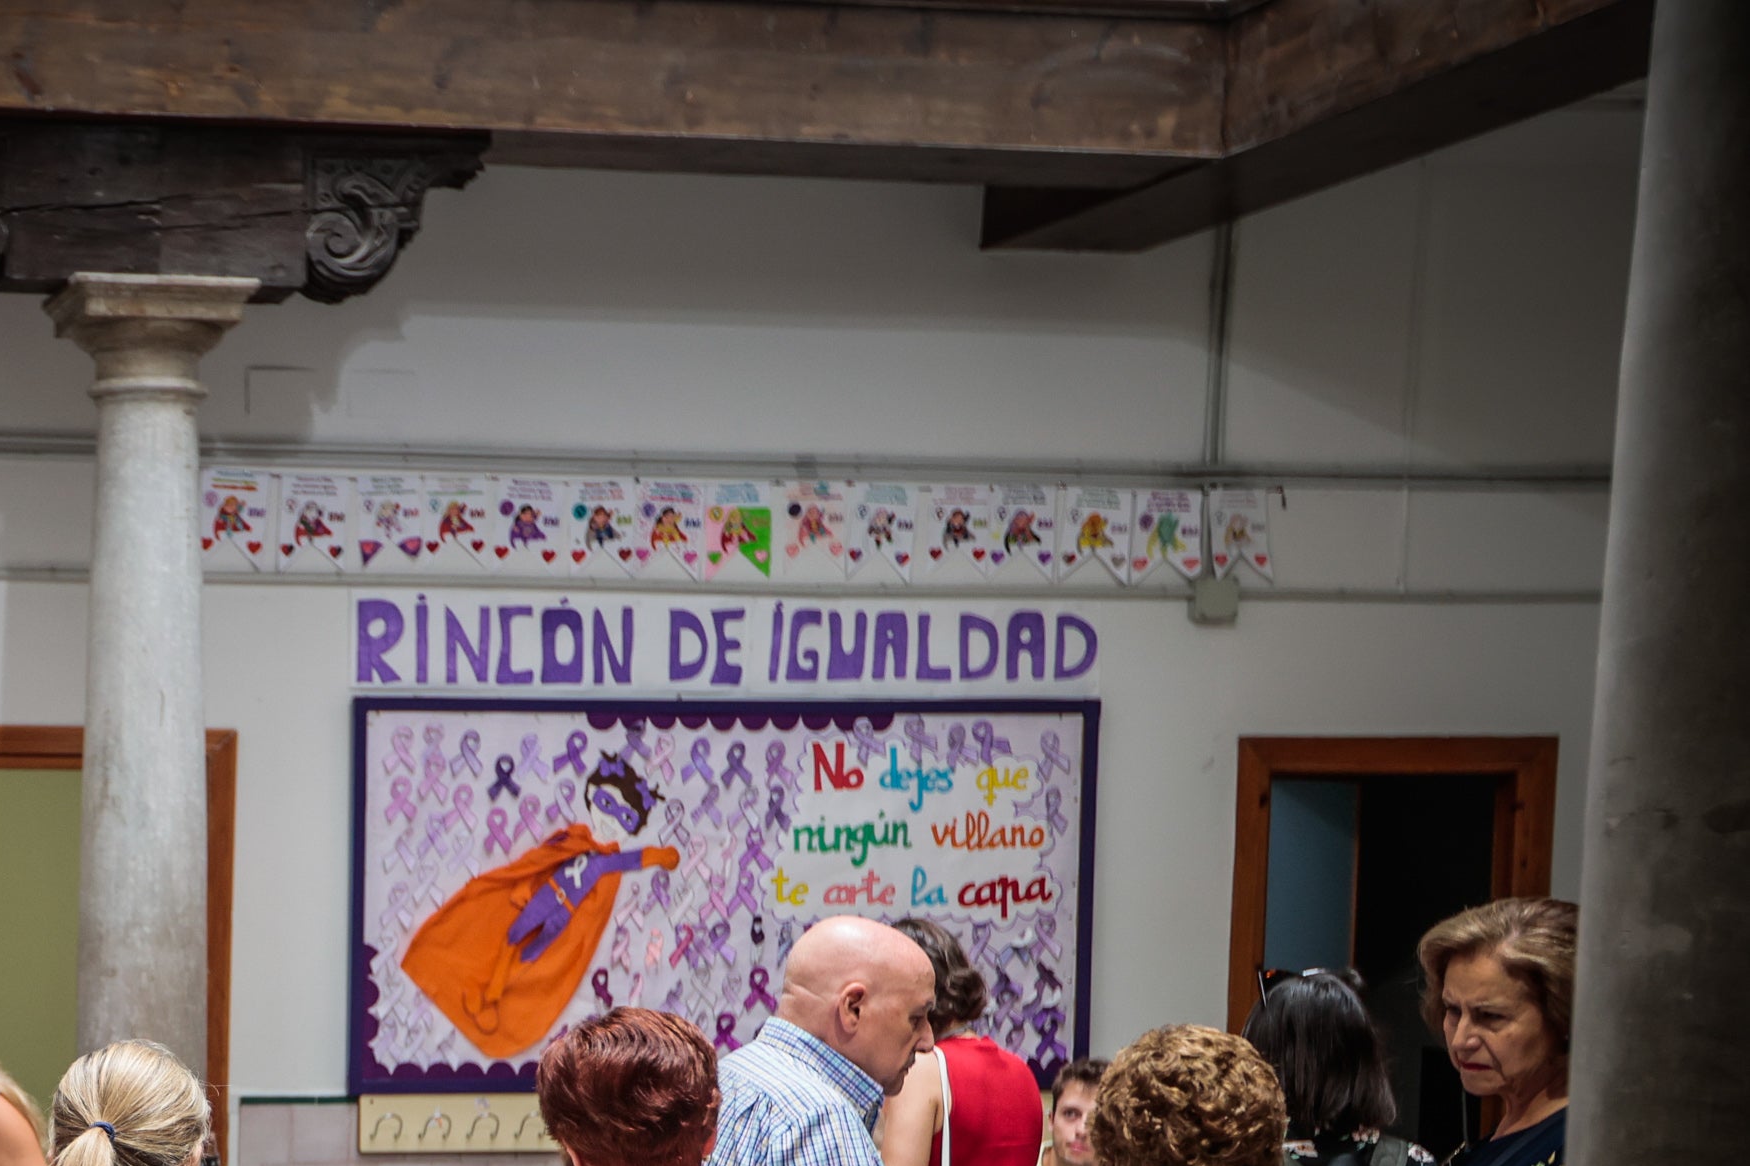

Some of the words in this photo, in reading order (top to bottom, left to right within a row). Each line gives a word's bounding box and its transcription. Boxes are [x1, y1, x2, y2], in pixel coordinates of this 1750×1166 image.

[355, 593, 634, 685] RINCÓN
[669, 608, 745, 685] DE
[768, 602, 1098, 682] IGUALDAD
[812, 741, 865, 792] No
[879, 746, 953, 812] dejes
[976, 765, 1029, 806] que
[793, 809, 912, 867] ningún
[930, 810, 1045, 851] villano
[770, 867, 809, 906] te
[823, 869, 896, 906] corte
[910, 866, 948, 906] la
[958, 875, 1052, 919] capa
